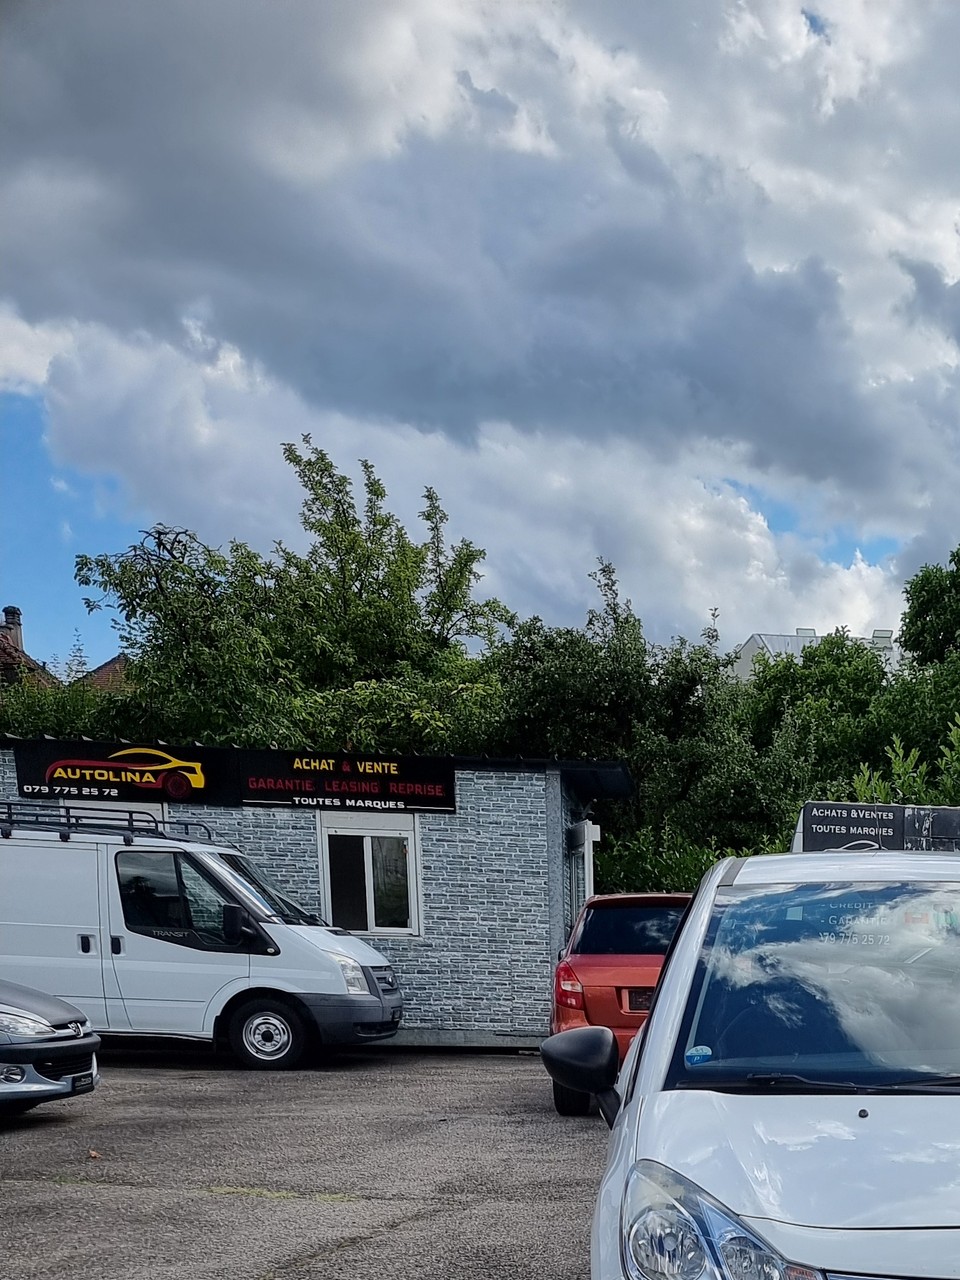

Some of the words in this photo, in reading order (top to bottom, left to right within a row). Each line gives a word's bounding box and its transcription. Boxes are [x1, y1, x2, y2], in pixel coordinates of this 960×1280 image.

[293, 757, 335, 770] ACHAT
[342, 760, 350, 772] &
[356, 761, 398, 774] VENTE
[53, 768, 156, 783] AUTOLINA
[23, 784, 49, 793] 079
[53, 786, 78, 795] 775
[82, 787, 98, 796] 25
[102, 788, 119, 797] 72
[248, 777, 314, 791] GARANTIE
[325, 780, 379, 793] LEASING
[389, 782, 443, 796] REPRISE
[293, 797, 341, 806] TOUTES
[346, 799, 405, 809] MARQUES
[811, 807, 848, 818] ACHATS
[811, 824, 847, 834] TOUTES
[850, 826, 894, 836] MARQUES
[152, 930, 190, 938] TRANSIT
[861, 934, 875, 945] 25
[877, 935, 890, 945] 72
